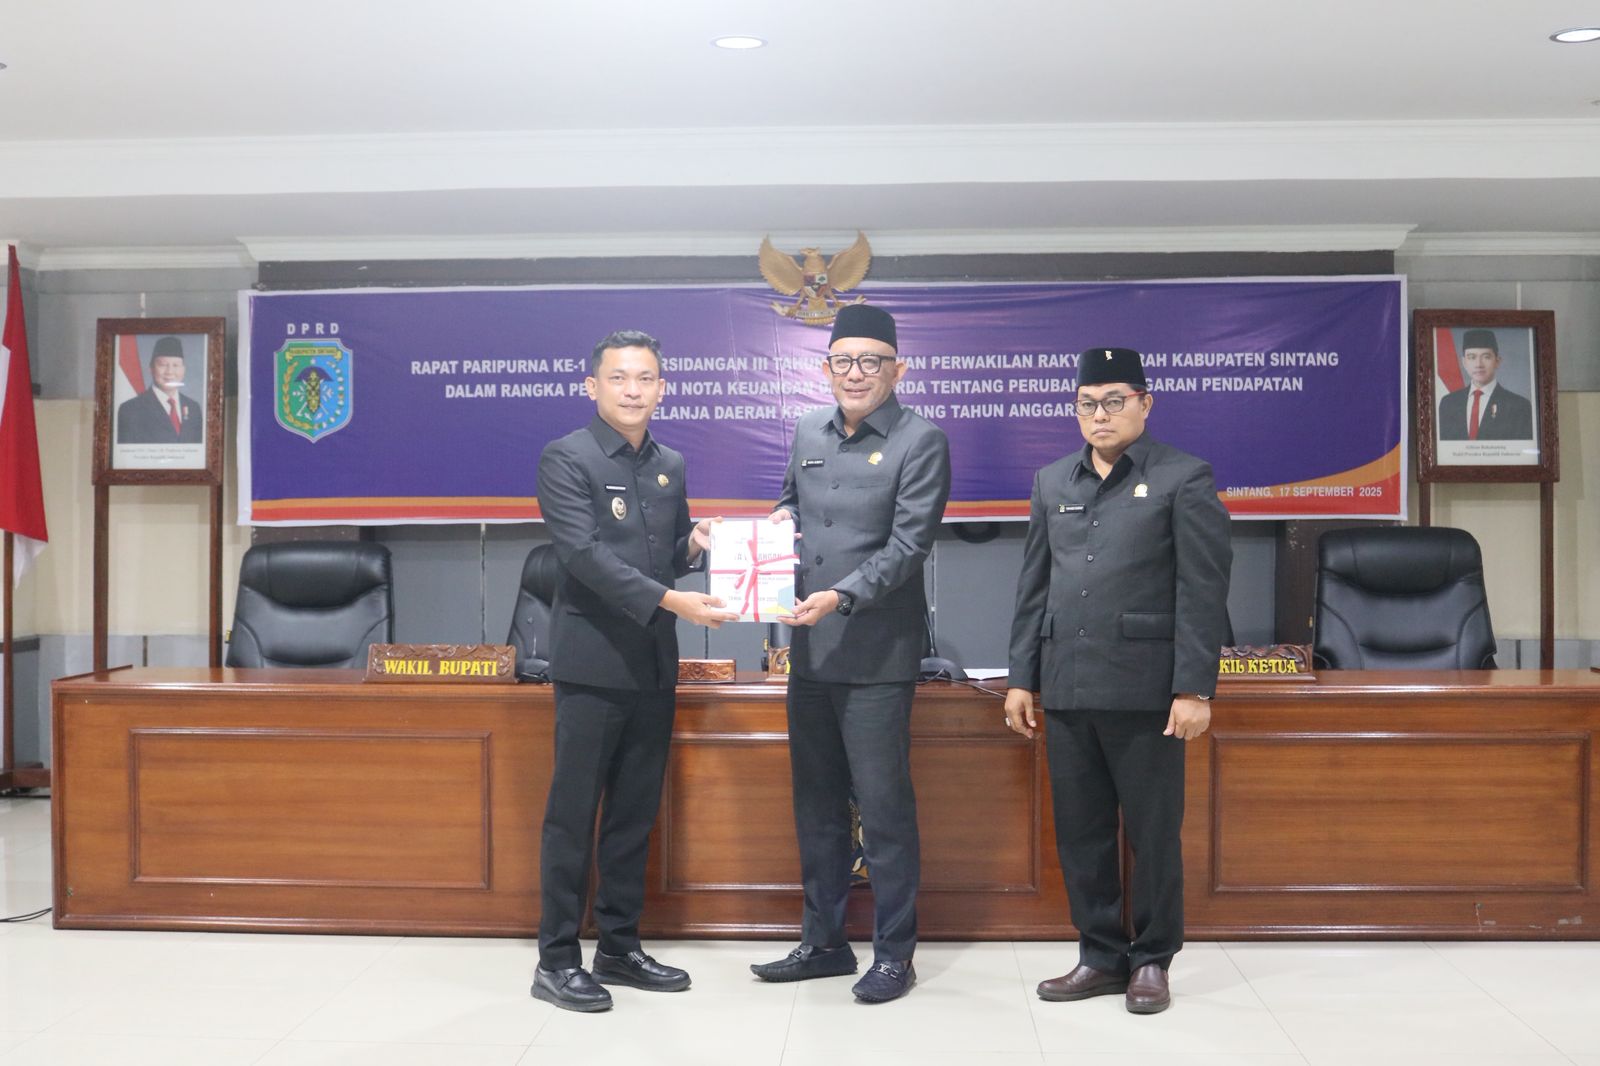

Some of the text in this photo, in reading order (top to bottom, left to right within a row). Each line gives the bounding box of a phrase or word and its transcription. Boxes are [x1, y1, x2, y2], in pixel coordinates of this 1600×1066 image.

[287, 323, 339, 335] DPRD
[411, 361, 458, 374] RAPAT
[463, 360, 549, 373] PARIPURNA
[553, 358, 586, 372] KE-1
[661, 357, 748, 371] RSIDANGAN
[753, 357, 768, 370] III
[773, 357, 823, 370] TAHUN
[931, 355, 1033, 370] PERWAKILAN
[1038, 354, 1080, 368] RAKY
[1172, 352, 1265, 367] KABUPATEN
[1270, 352, 1339, 366] SINTANG
[445, 384, 496, 398] DALAM
[501, 383, 564, 397] RANGKA
[682, 381, 723, 395] NOTA
[727, 381, 812, 395] KEUANGAN
[930, 379, 1004, 394] TENTANG
[1008, 378, 1077, 393] PERUBA
[1145, 377, 1197, 392] GARAN
[1202, 377, 1303, 391] PENDAPATAN
[651, 406, 710, 420] ELANJA
[714, 405, 776, 420] DAERAH
[951, 404, 1004, 418] TAHUN
[1008, 403, 1078, 417] ANGGAR
[1226, 486, 1382, 498] SINTANG, 17 SEPTEMBER 2025
[384, 660, 497, 676] WAKIL BUPATI
[1219, 659, 1297, 674] KIL KETUA
